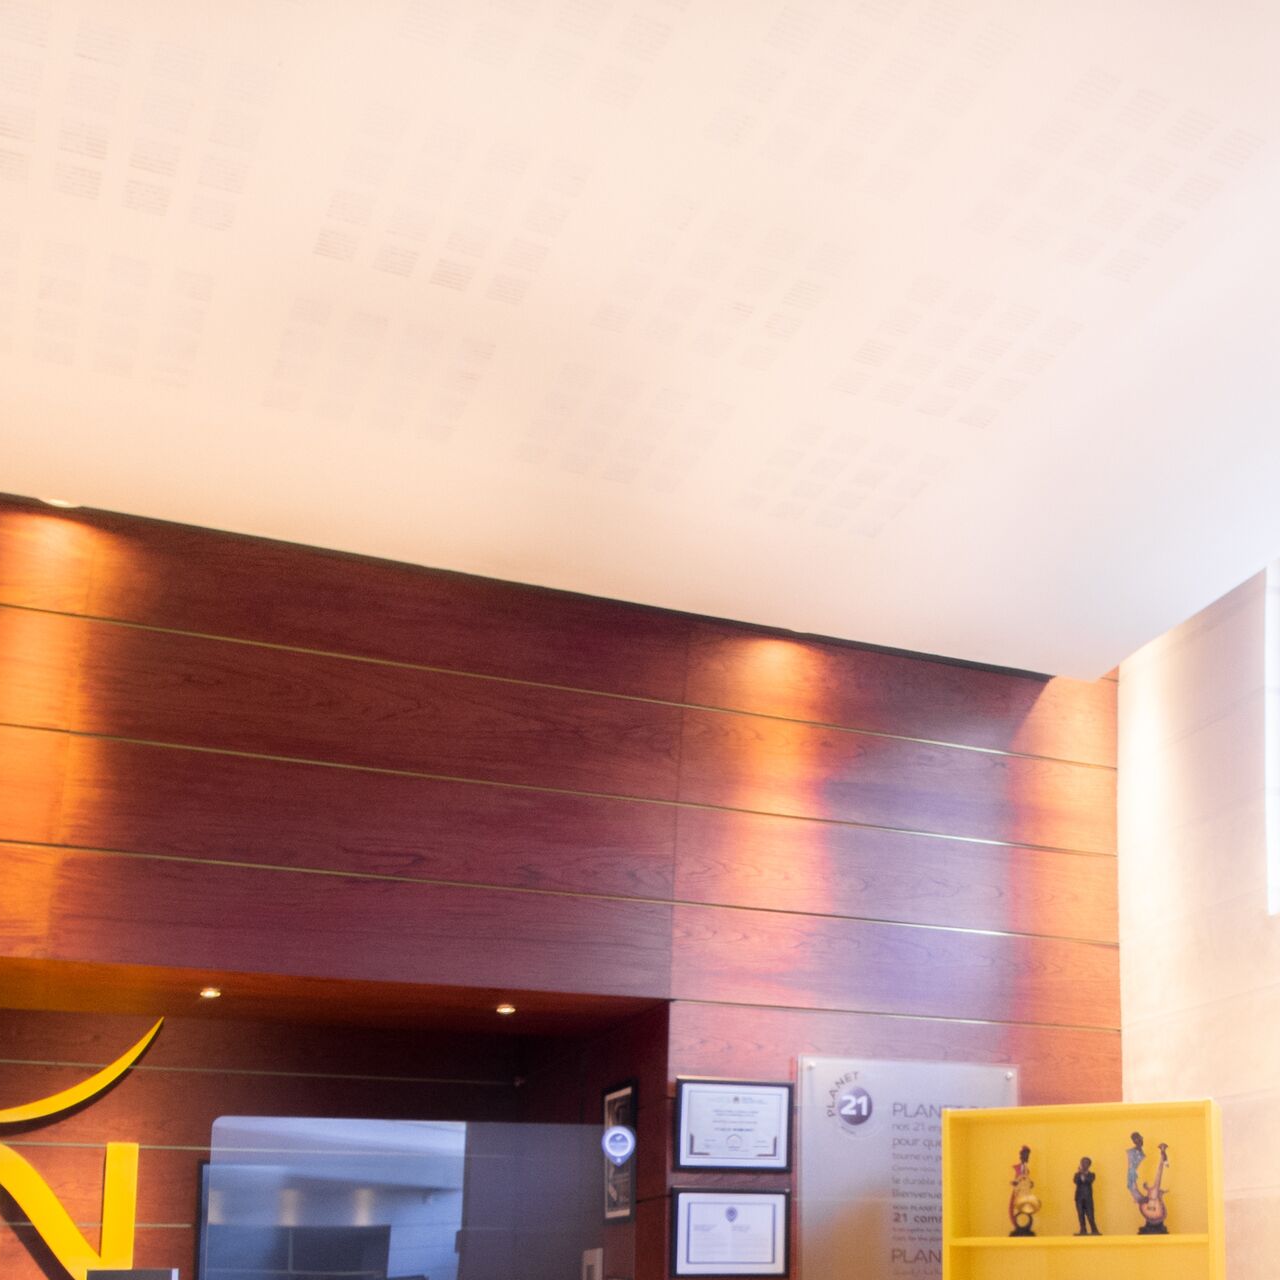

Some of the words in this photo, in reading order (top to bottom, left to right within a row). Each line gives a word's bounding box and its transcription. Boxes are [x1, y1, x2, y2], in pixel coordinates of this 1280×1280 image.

[826, 1071, 859, 1118] PLANET
[840, 1094, 868, 1116] 21
[891, 1138, 919, 1149] pour
[892, 1212, 908, 1223] 21
[891, 1248, 942, 1264] PLAN
